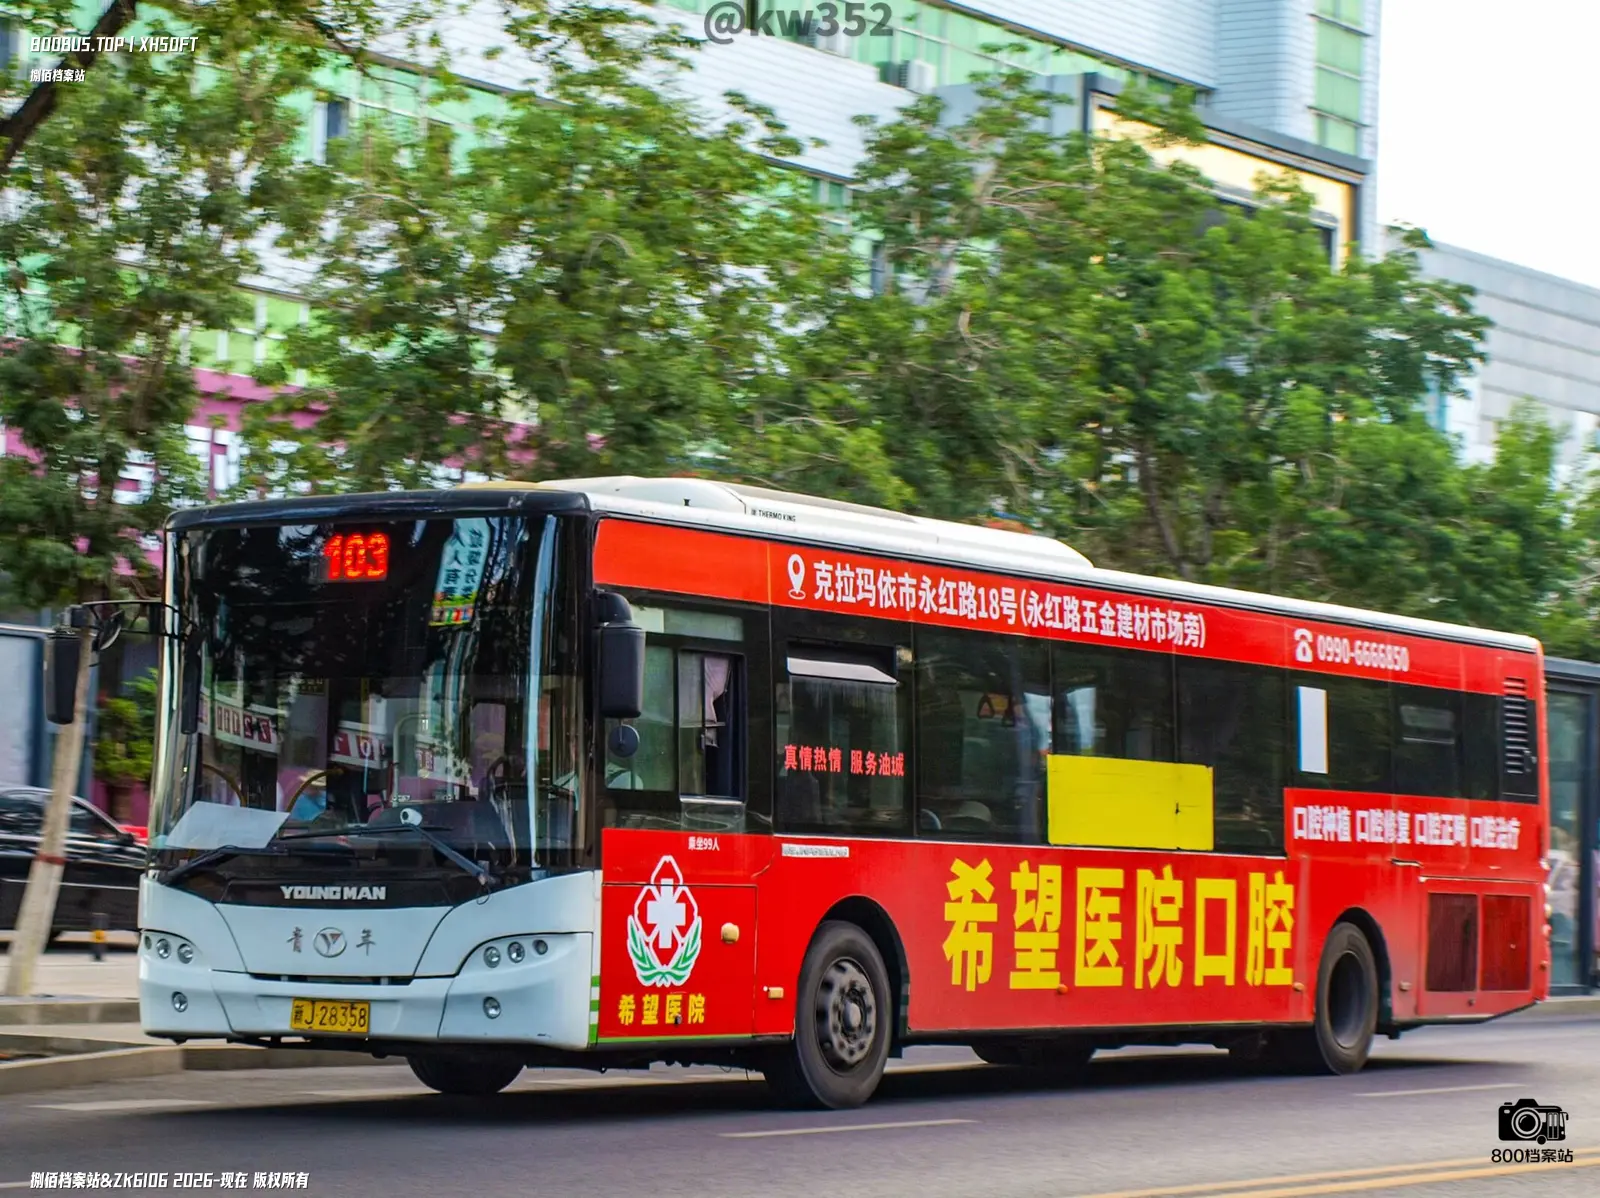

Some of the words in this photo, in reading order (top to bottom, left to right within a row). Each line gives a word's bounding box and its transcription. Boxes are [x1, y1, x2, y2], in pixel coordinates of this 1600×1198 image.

[759, 509, 782, 520] THERMO
[782, 514, 796, 522] KING
[323, 532, 389, 580] 103
[813, 560, 1207, 649] 克拉玛依市永红路18号(永红路五金建材市场旁)
[784, 744, 842, 773] 真情热情
[850, 749, 905, 777] 服务油城
[1293, 805, 1352, 842] 口腔种植
[942, 857, 1296, 992] 希望医院口腔
[618, 993, 706, 1026] 希望医院
